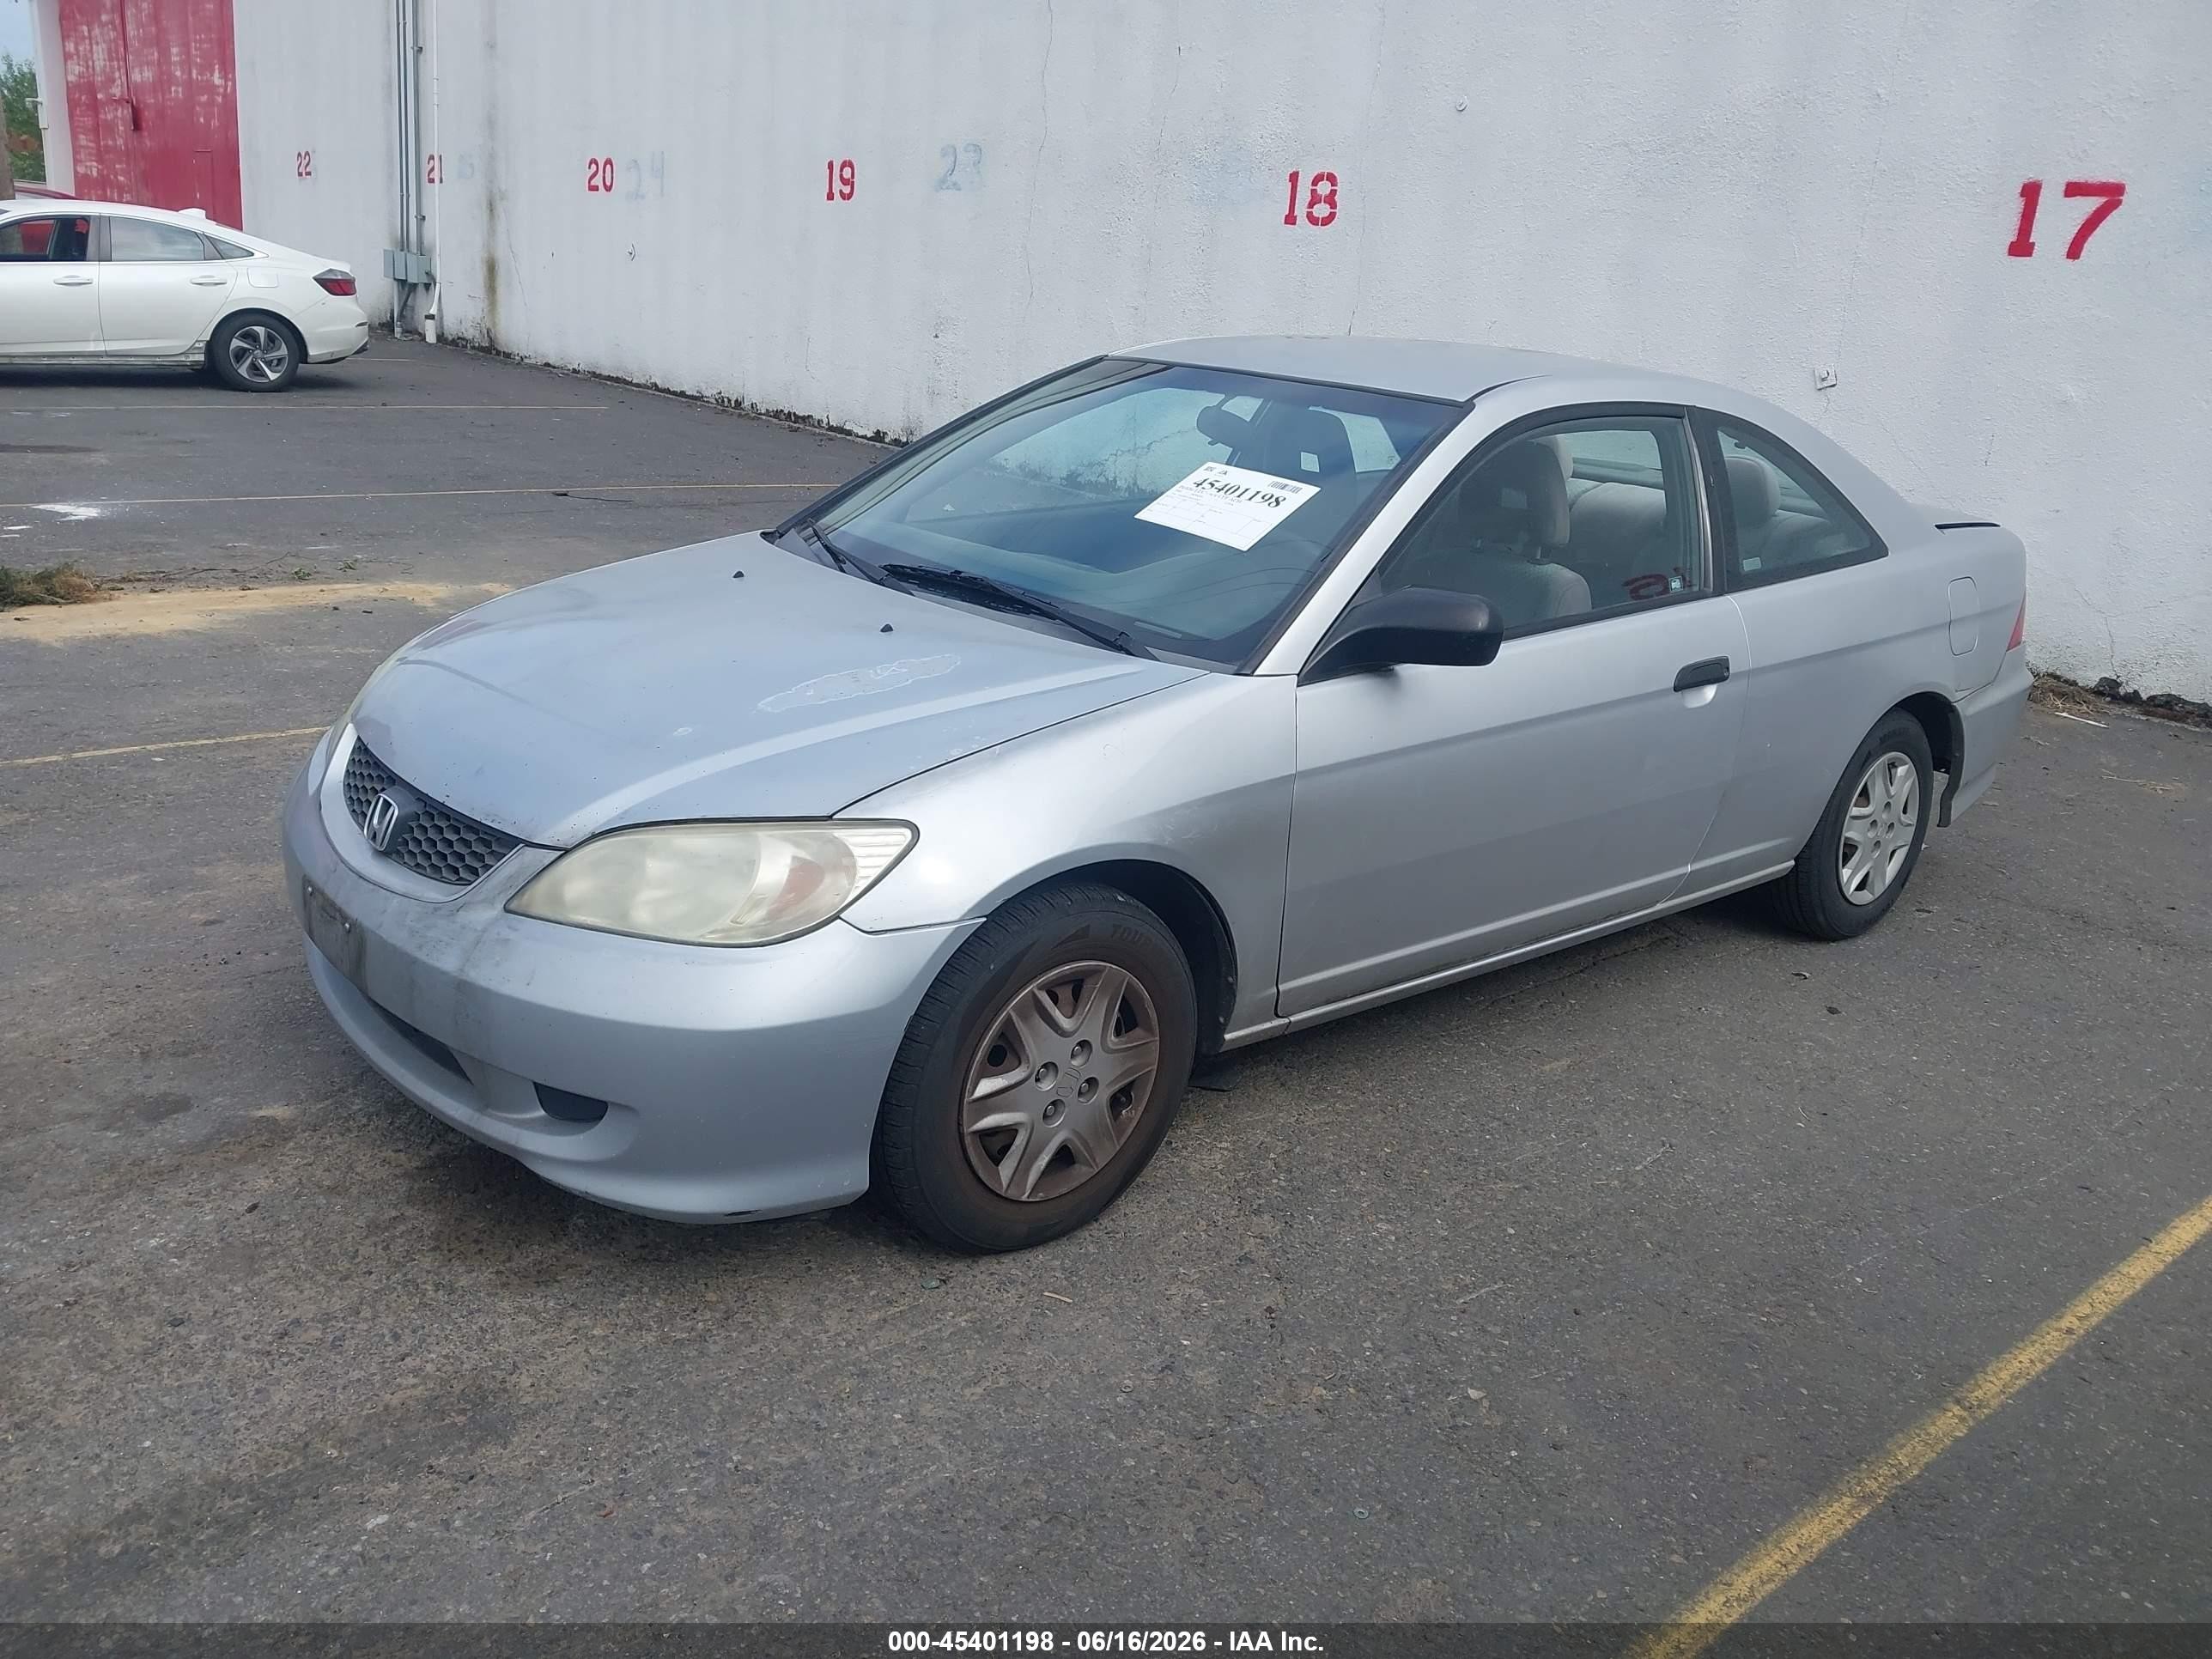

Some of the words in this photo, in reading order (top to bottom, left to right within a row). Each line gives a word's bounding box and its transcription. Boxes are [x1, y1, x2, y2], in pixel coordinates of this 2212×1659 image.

[296, 151, 312, 177] 22
[427, 154, 443, 184] 21
[587, 157, 615, 193] 20
[826, 160, 855, 202] 19
[1284, 171, 1339, 228] 18
[2008, 179, 2127, 262] 17
[1192, 477, 1287, 508] 45401198
